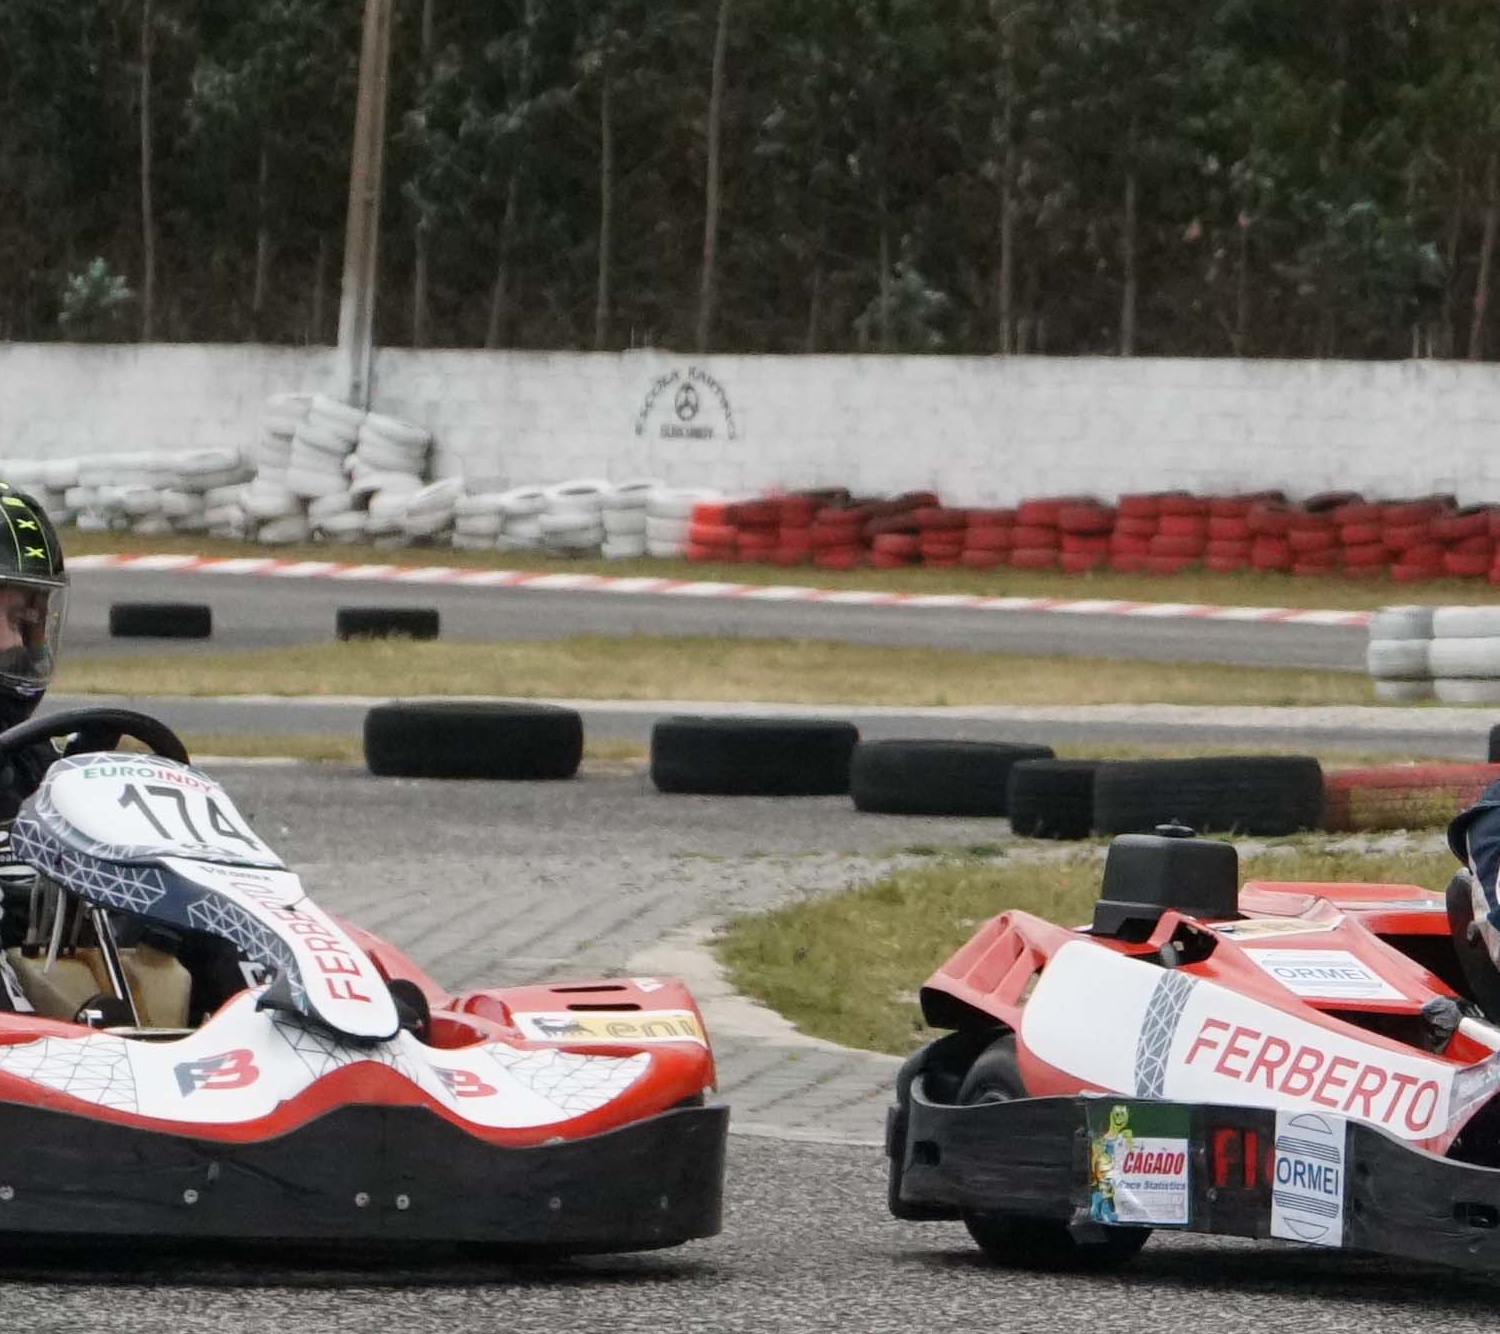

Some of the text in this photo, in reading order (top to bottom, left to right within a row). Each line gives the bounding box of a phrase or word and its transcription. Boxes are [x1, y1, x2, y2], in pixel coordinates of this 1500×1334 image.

[83, 765, 218, 792] EUROINDY
[117, 783, 262, 851] 174
[1274, 968, 1373, 981] ORMEI
[1184, 1018, 1440, 1132] FERBERTO
[1276, 1156, 1340, 1197] ORMEI
